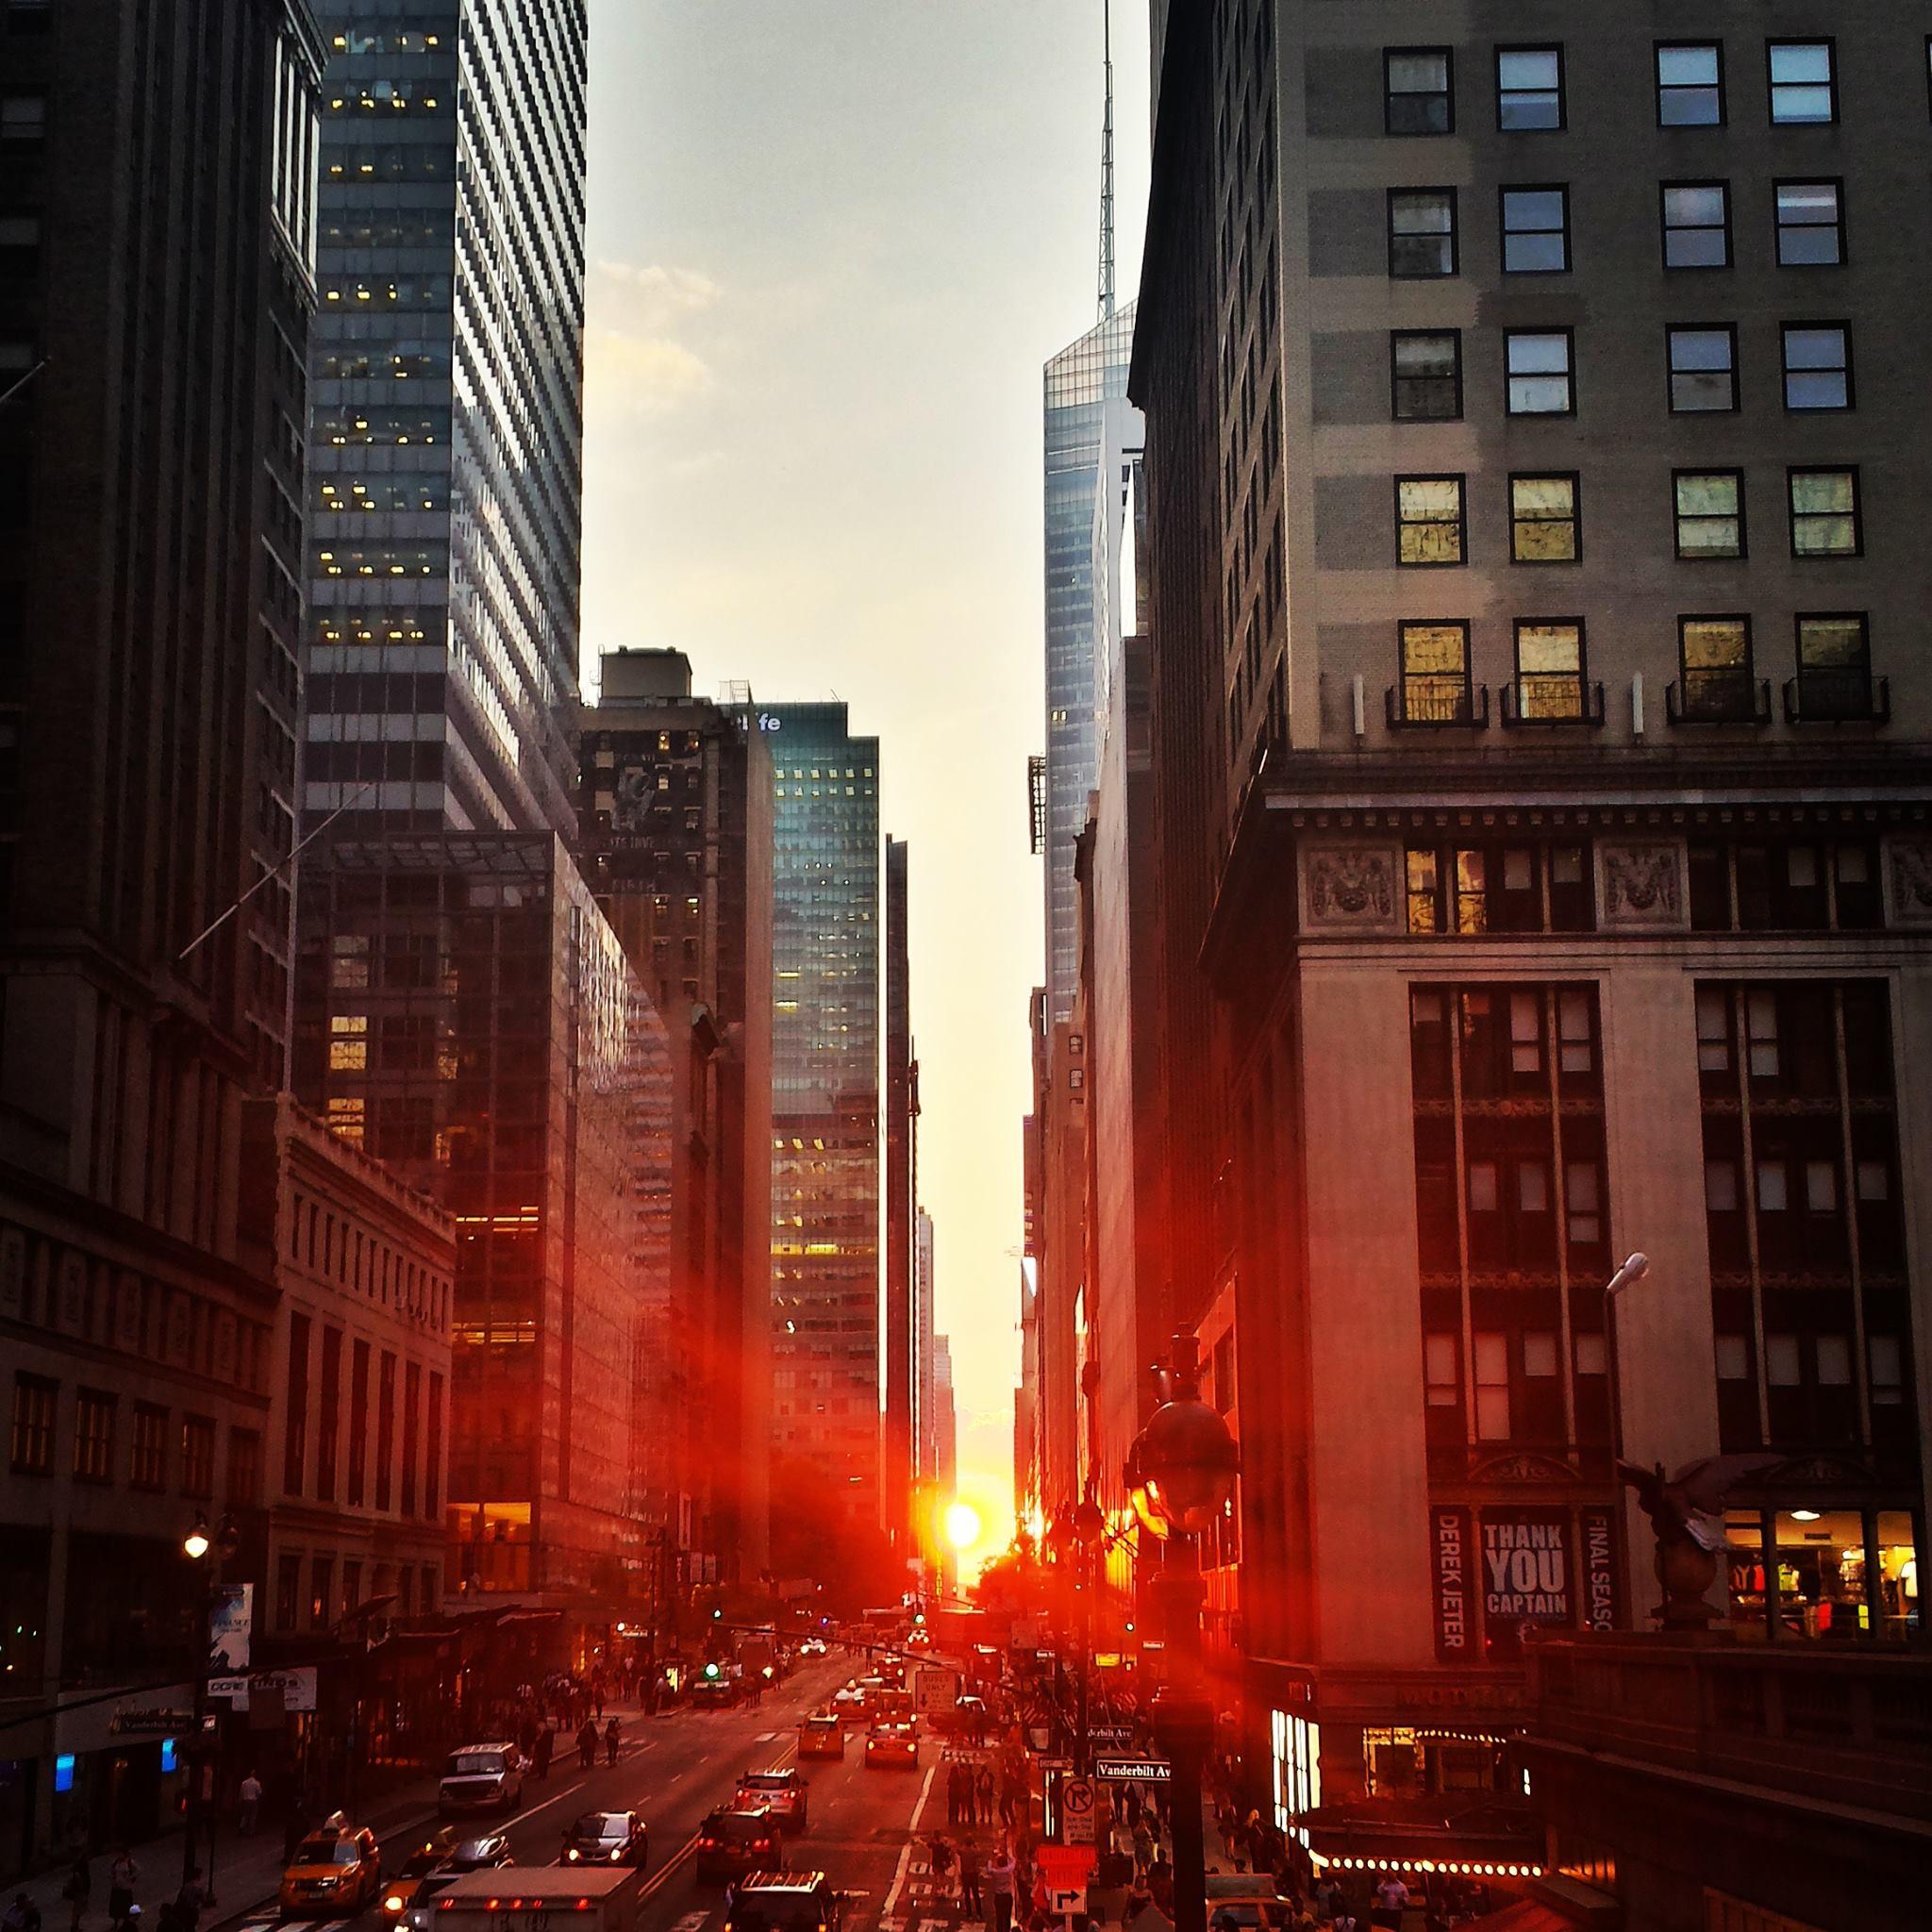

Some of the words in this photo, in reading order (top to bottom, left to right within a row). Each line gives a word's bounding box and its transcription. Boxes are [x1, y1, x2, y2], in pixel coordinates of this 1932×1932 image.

[1439, 1514, 1462, 1584] DEREK
[1484, 1524, 1563, 1548] THANK
[1589, 1514, 1609, 1569] FINAL
[1485, 1548, 1564, 1593] YOU
[1441, 1588, 1465, 1648] JETER
[1487, 1593, 1567, 1614] CAPTAIN
[1591, 1572, 1613, 1630] SEASO
[1116, 1727, 1132, 1738] Ave
[1099, 1763, 1155, 1777] Vanderbilt
[1157, 1765, 1171, 1777] Av
